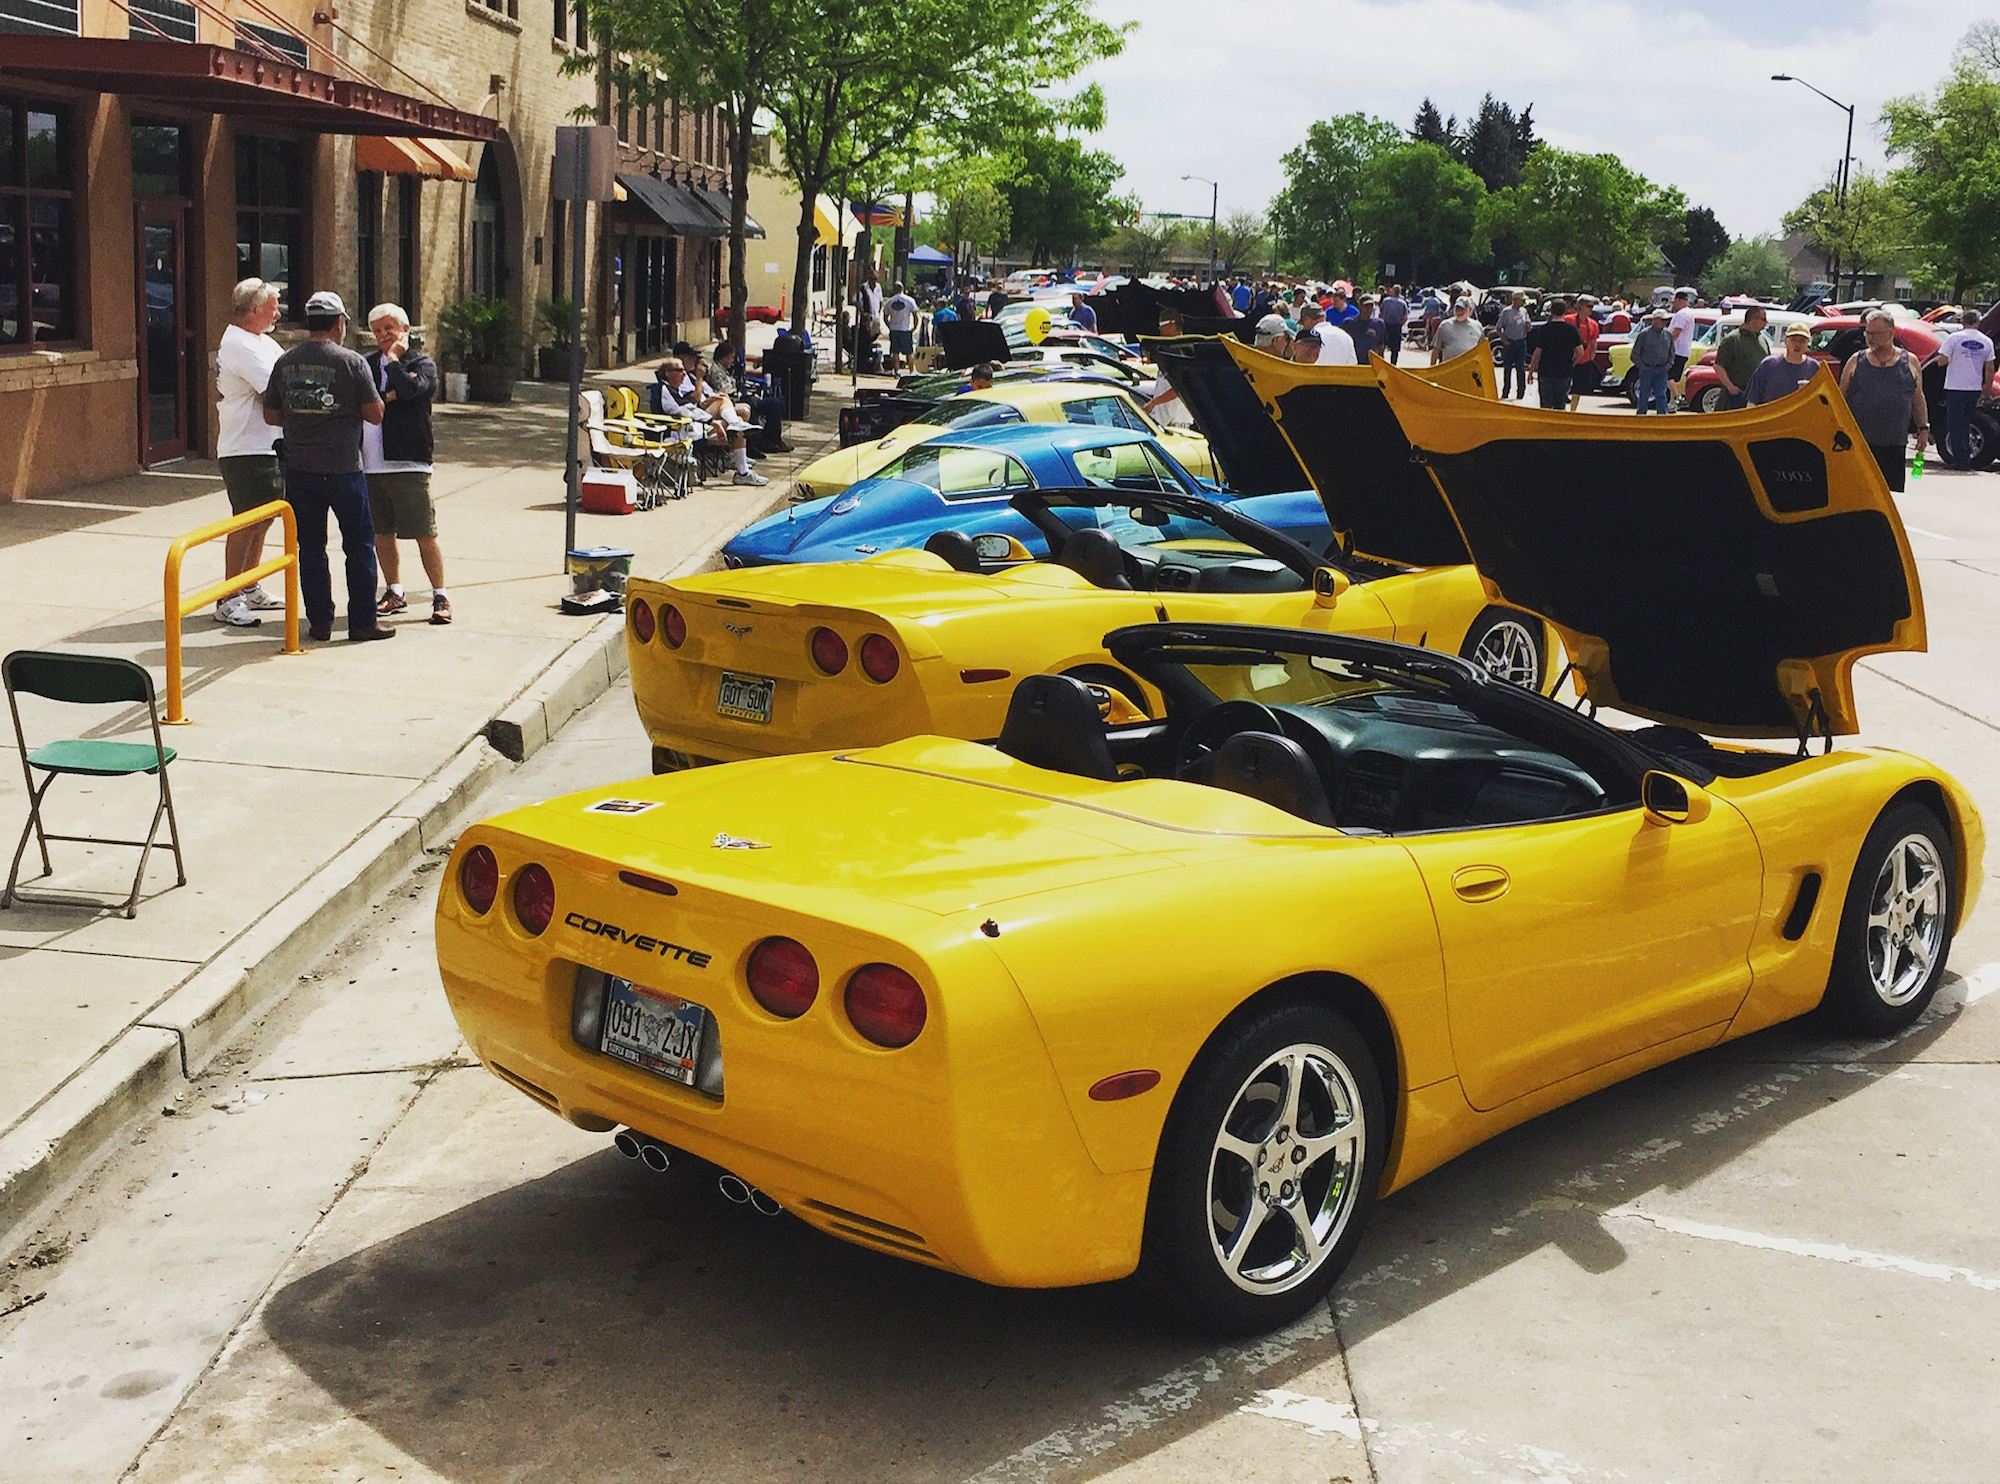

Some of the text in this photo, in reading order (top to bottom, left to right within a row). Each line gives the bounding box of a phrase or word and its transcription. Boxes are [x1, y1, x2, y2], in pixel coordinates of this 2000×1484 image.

[1772, 469, 1813, 483] 2003
[723, 684, 742, 705] GOT
[564, 912, 712, 969] CORVETTE
[612, 1000, 642, 1043] 091
